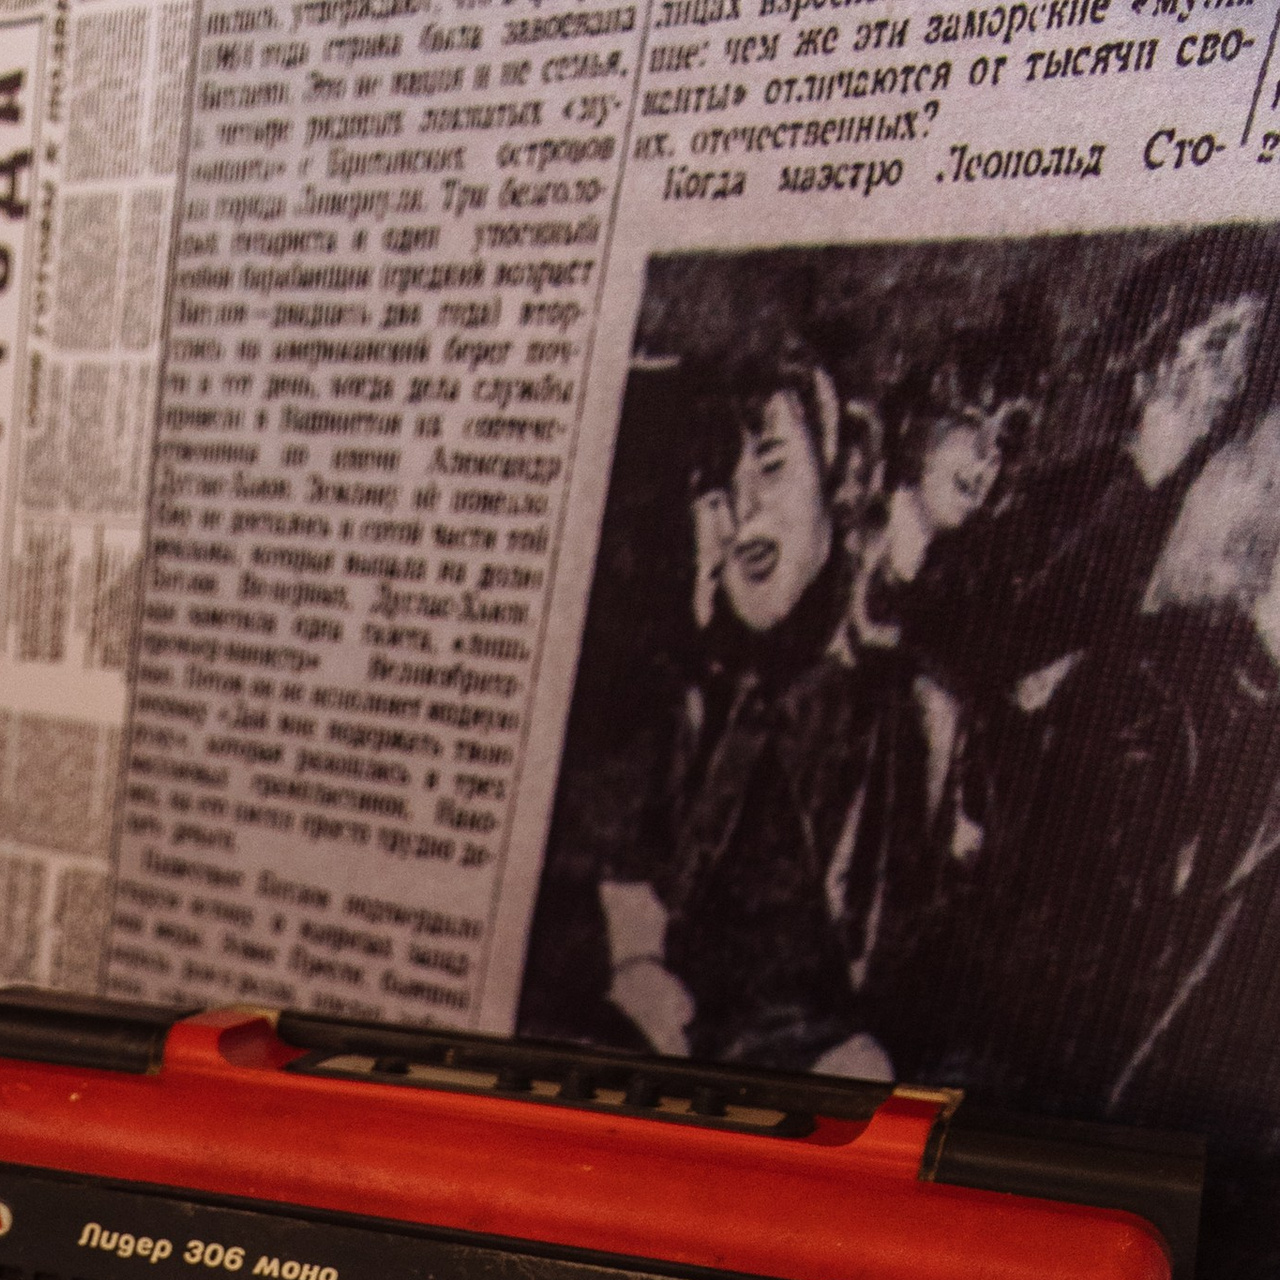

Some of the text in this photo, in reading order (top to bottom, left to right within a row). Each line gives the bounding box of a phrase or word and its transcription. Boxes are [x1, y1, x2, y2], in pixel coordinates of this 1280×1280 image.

[1142, 126, 1228, 171] Сто-
[77, 1221, 173, 1264] Лидер
[182, 1238, 247, 1272] 306
